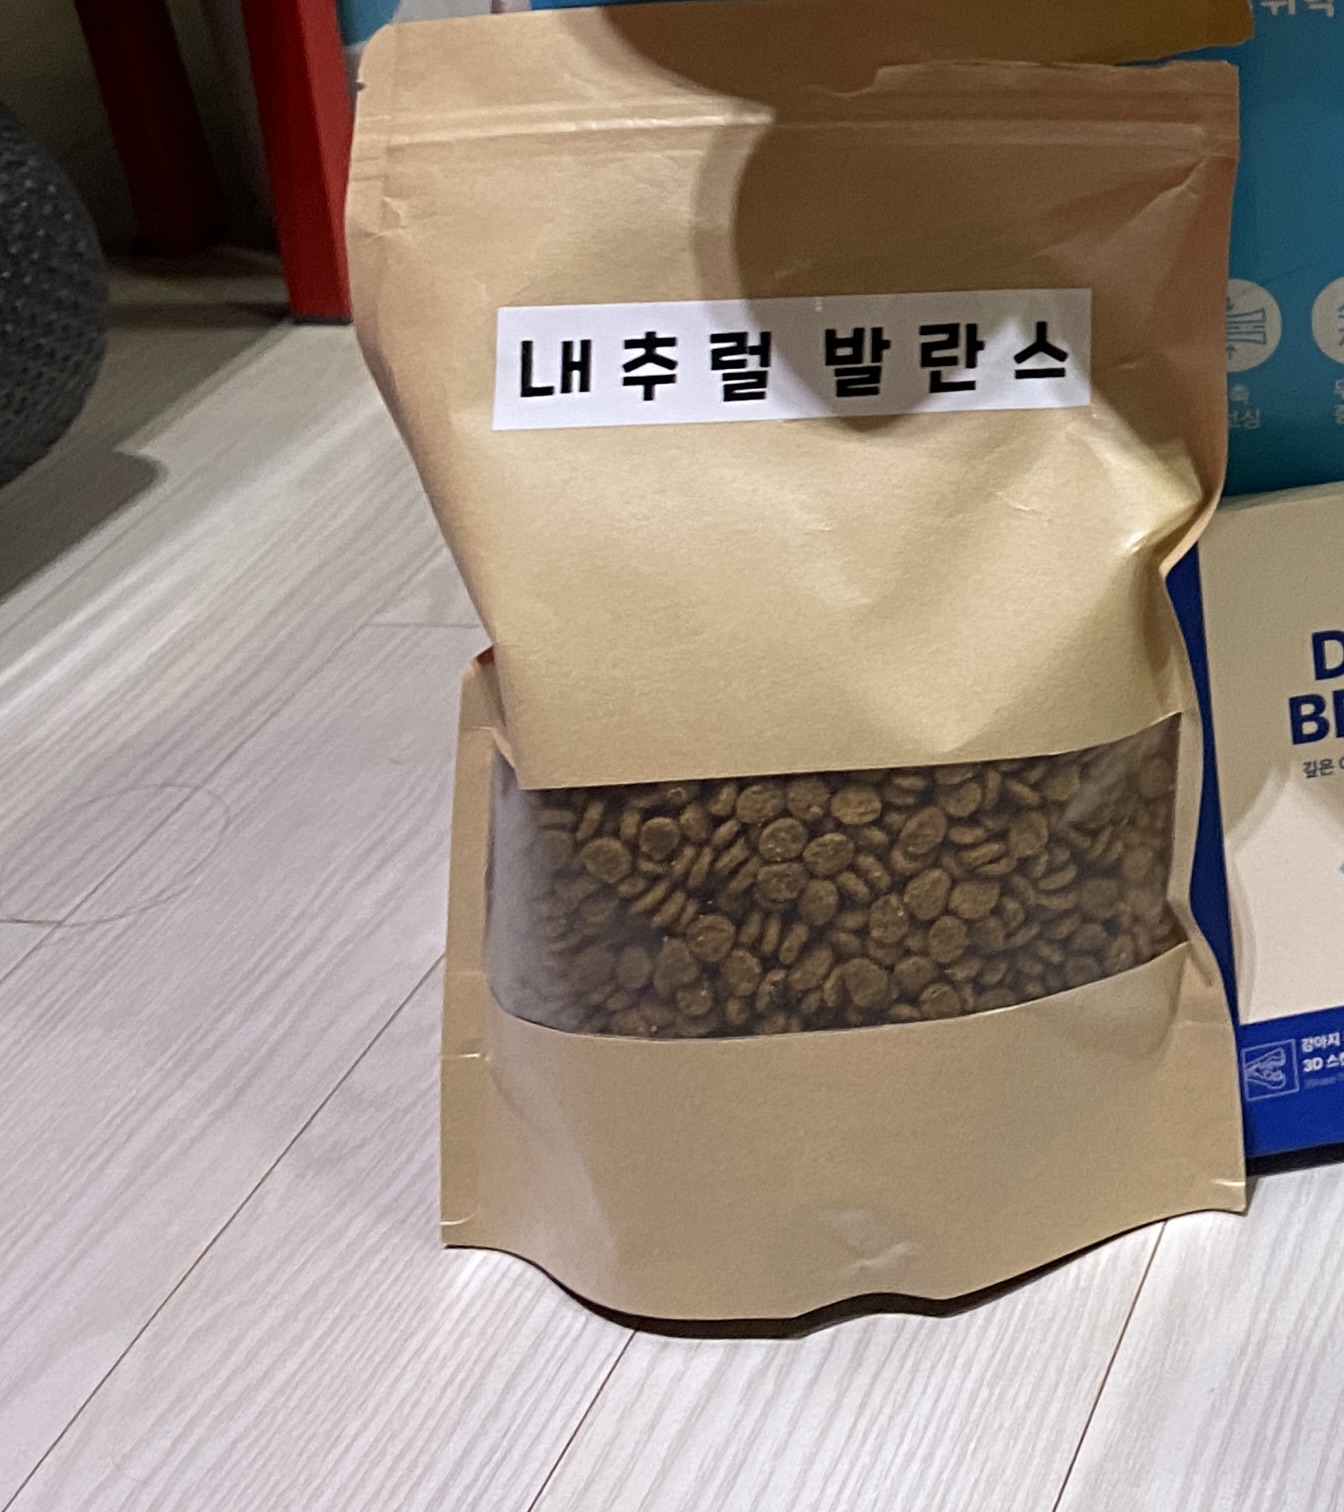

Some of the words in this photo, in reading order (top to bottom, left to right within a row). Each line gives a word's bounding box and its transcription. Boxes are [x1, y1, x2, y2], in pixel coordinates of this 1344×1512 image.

[519, 331, 772, 404] 내추럴
[824, 321, 1069, 398] 발란스
[1303, 758, 1334, 778] 깊은
[1301, 1032, 1340, 1053] 강아지
[1302, 1057, 1323, 1073] 3D
